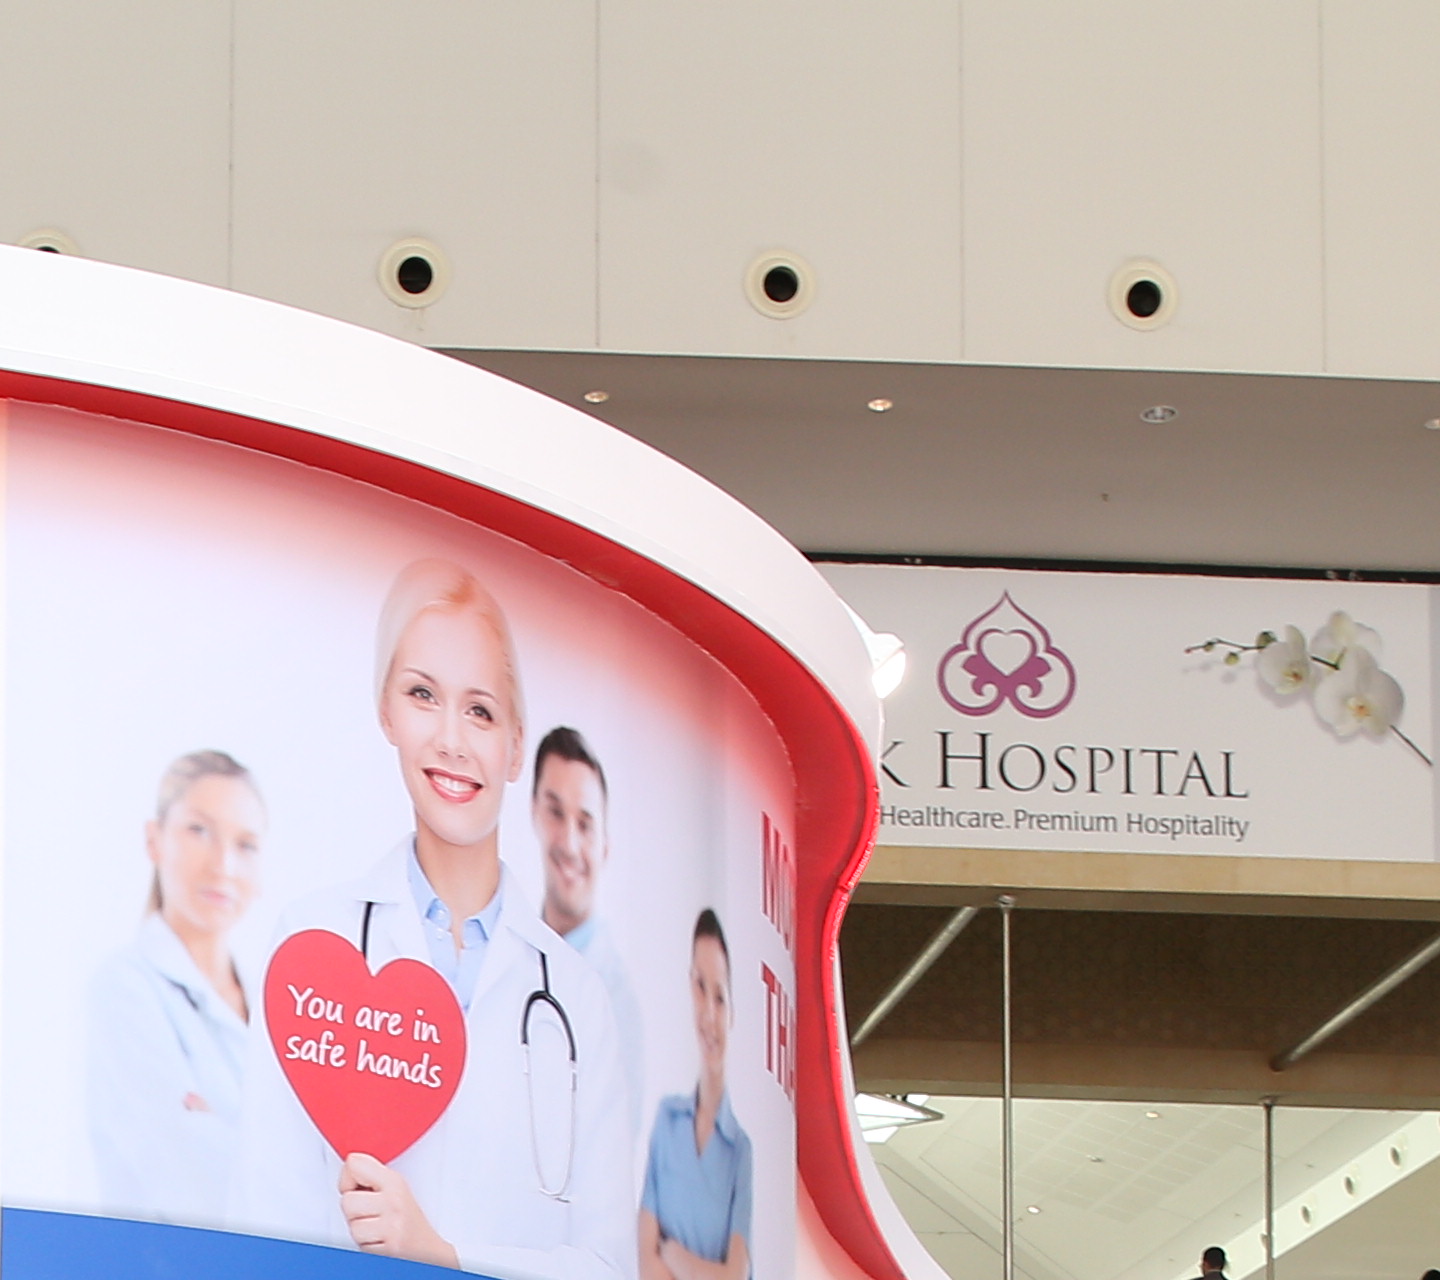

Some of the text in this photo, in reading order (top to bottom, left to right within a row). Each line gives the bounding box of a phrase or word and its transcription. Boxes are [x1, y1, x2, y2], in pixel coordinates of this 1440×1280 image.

[1014, 808, 1118, 833] Premium
[1125, 811, 1250, 843] Hospitality
[287, 984, 441, 1044] You are in
[285, 1030, 442, 1088] safe hands
